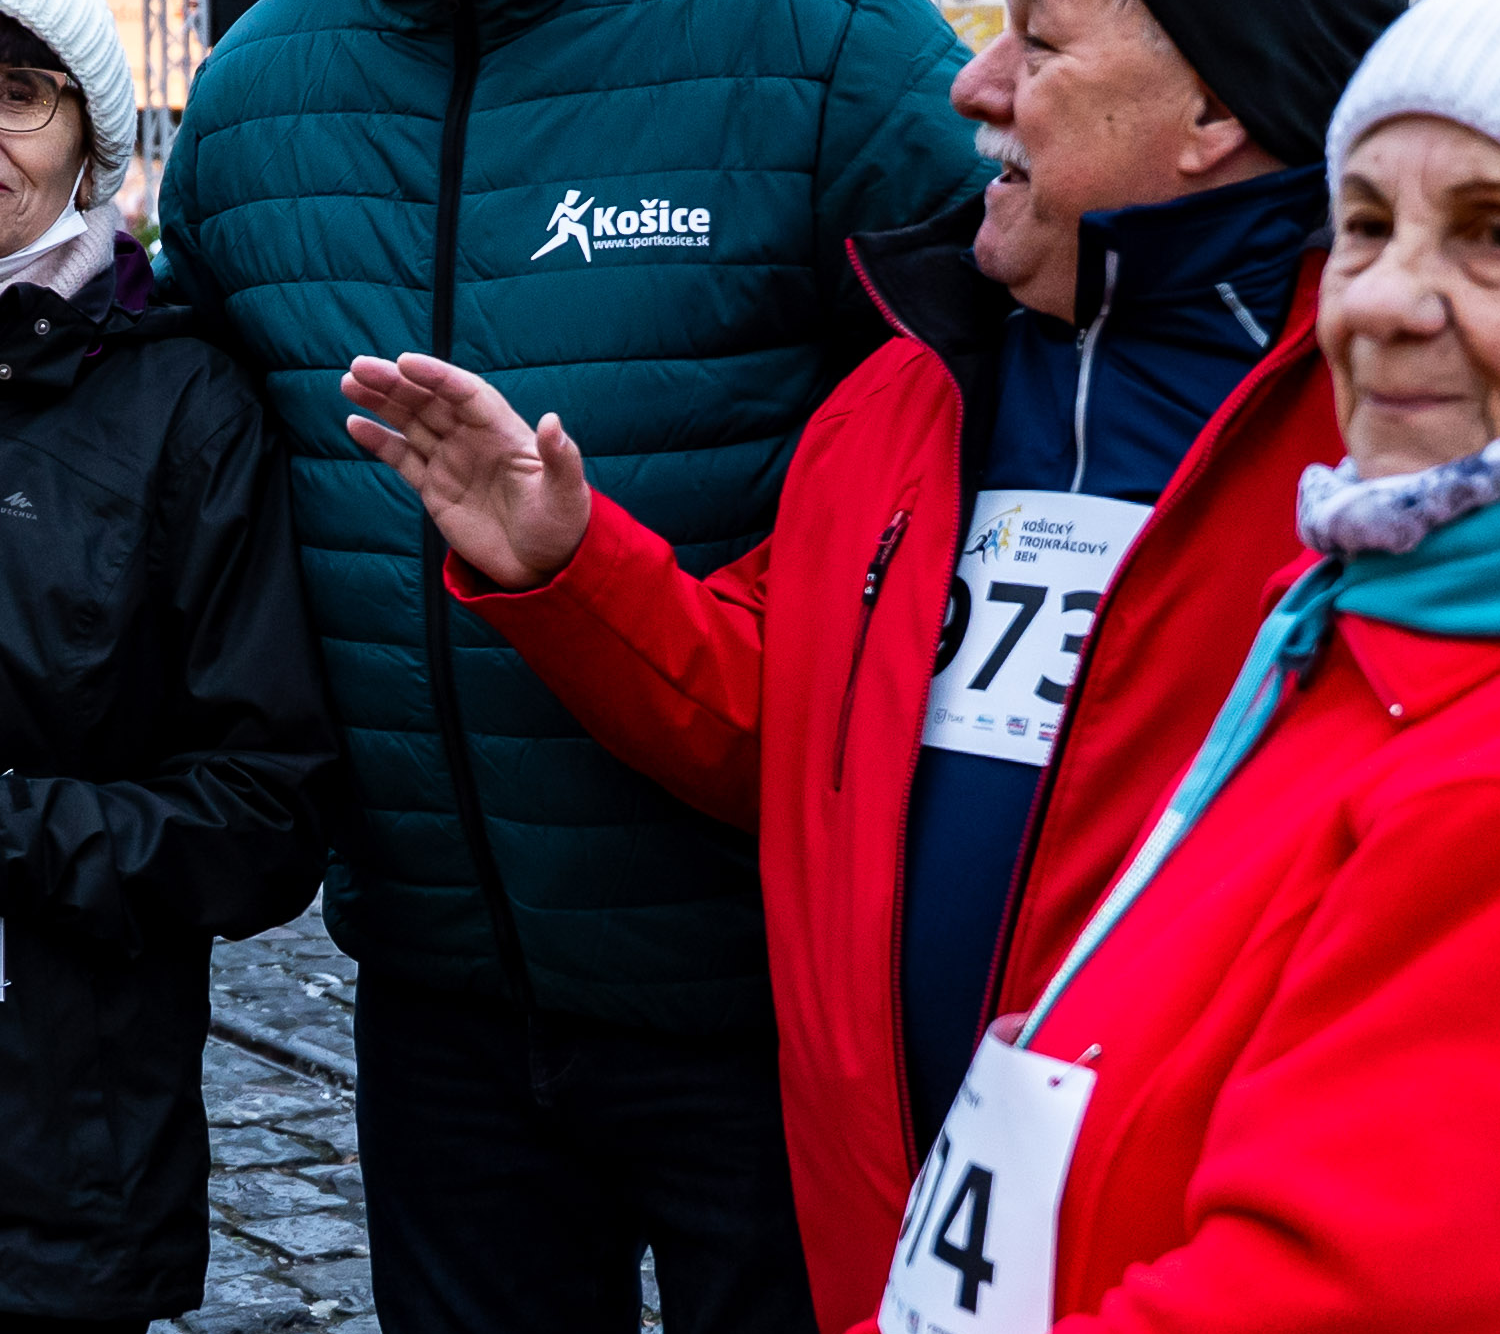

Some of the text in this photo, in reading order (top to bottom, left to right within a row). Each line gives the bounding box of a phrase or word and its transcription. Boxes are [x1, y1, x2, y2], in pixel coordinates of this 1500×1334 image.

[593, 198, 711, 237] Košice
[592, 234, 710, 250] www.sportkosice.sk
[1021, 517, 1075, 535] KOŠICKÝ
[1013, 550, 1038, 563] BEH
